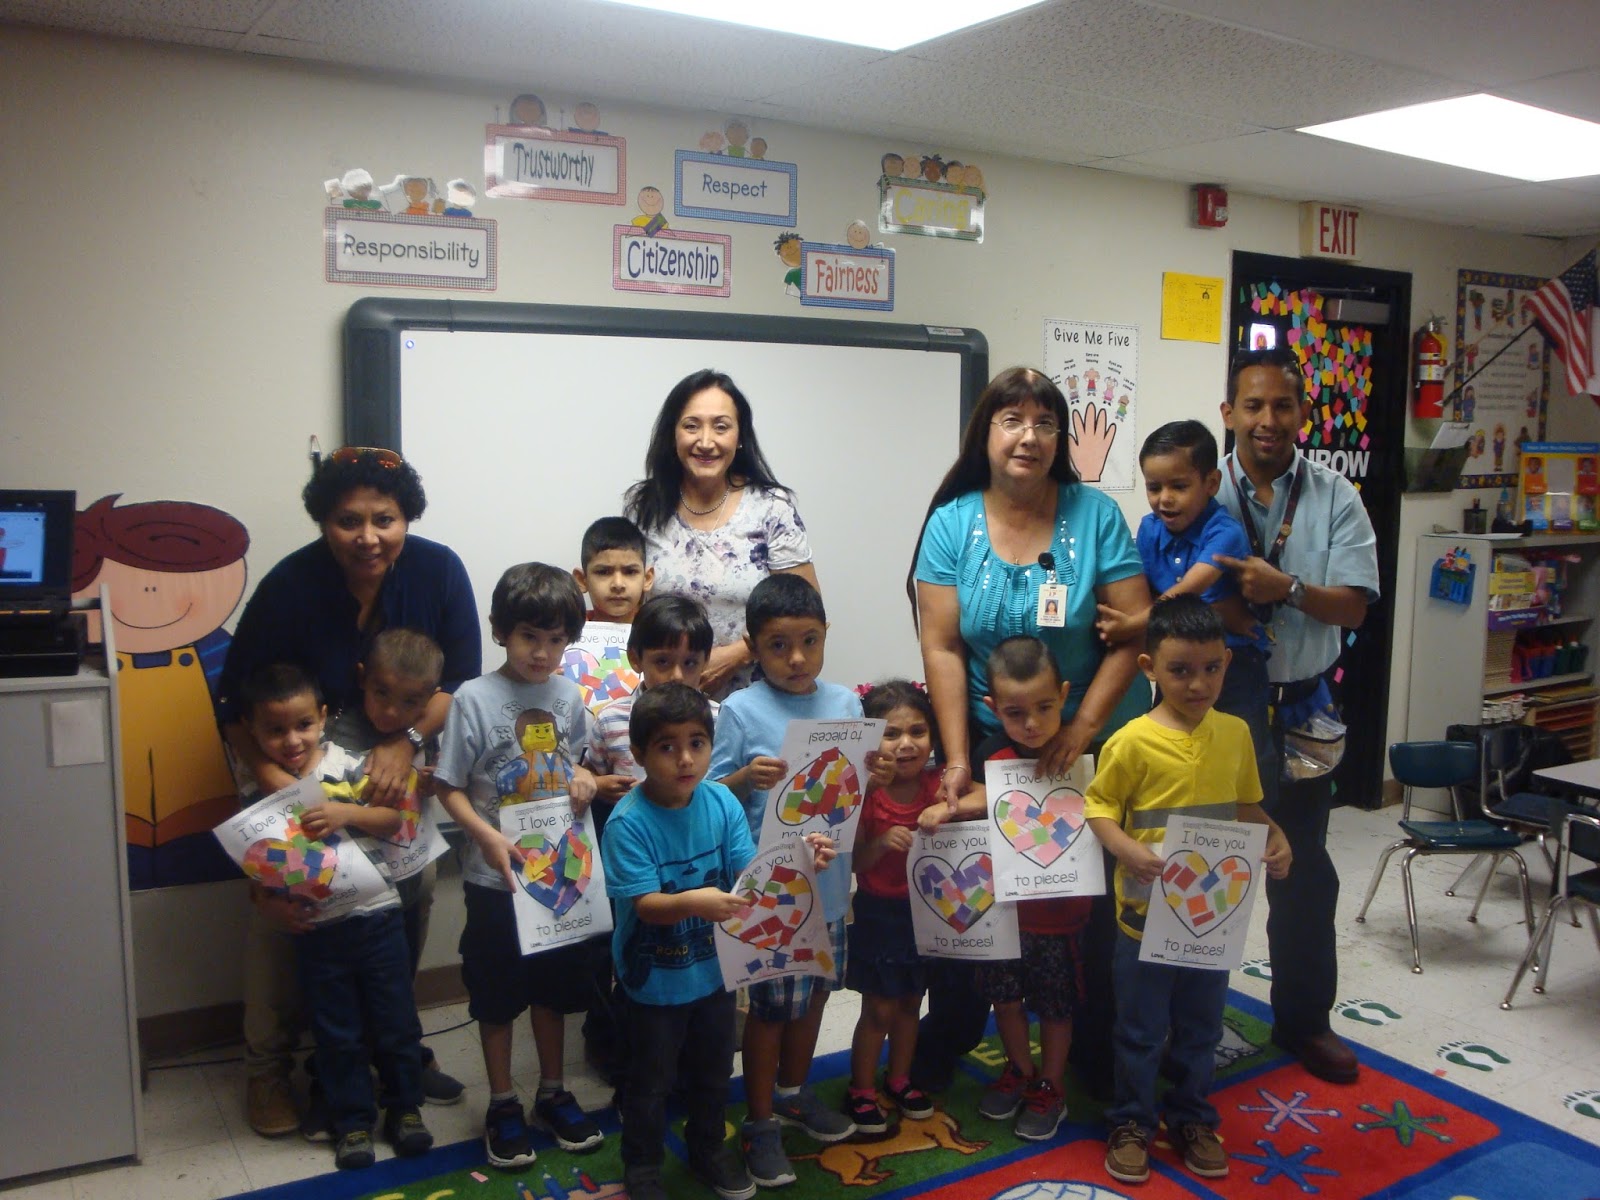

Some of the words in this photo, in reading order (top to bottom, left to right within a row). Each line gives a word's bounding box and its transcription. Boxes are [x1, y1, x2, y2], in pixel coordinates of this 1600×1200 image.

[513, 142, 595, 187] Trustworthy
[703, 173, 768, 199] Respect
[895, 187, 969, 231] Caring
[1319, 207, 1359, 255] EXIT
[344, 233, 480, 268] Responsibility
[627, 239, 719, 283] Citizenship
[815, 259, 879, 295] Fairness
[1054, 327, 1079, 343] Give
[1085, 330, 1103, 345] Me
[1108, 331, 1130, 347] Five
[580, 635, 600, 644] ove
[603, 635, 625, 646] you
[808, 728, 848, 745] pieces!
[851, 730, 862, 743] to
[1004, 773, 1012, 786] I
[1016, 773, 1042, 785] love
[238, 827, 251, 842] I
[250, 815, 277, 835] love
[518, 817, 527, 832] I
[530, 816, 557, 829] love
[833, 828, 842, 841] I
[920, 837, 928, 850] I
[931, 837, 958, 850] love
[961, 836, 987, 851] you
[1181, 830, 1191, 844] I
[1193, 832, 1220, 848] love
[1224, 838, 1246, 853] you
[740, 865, 762, 885] ove
[766, 853, 794, 871] you
[1014, 874, 1030, 887] to
[1034, 869, 1079, 889] pieces!
[536, 924, 551, 938] to
[554, 912, 593, 936] pieces!
[934, 933, 949, 947] to
[952, 934, 994, 949] pieces!
[1164, 937, 1180, 951] to
[1183, 941, 1226, 957] pieces!
